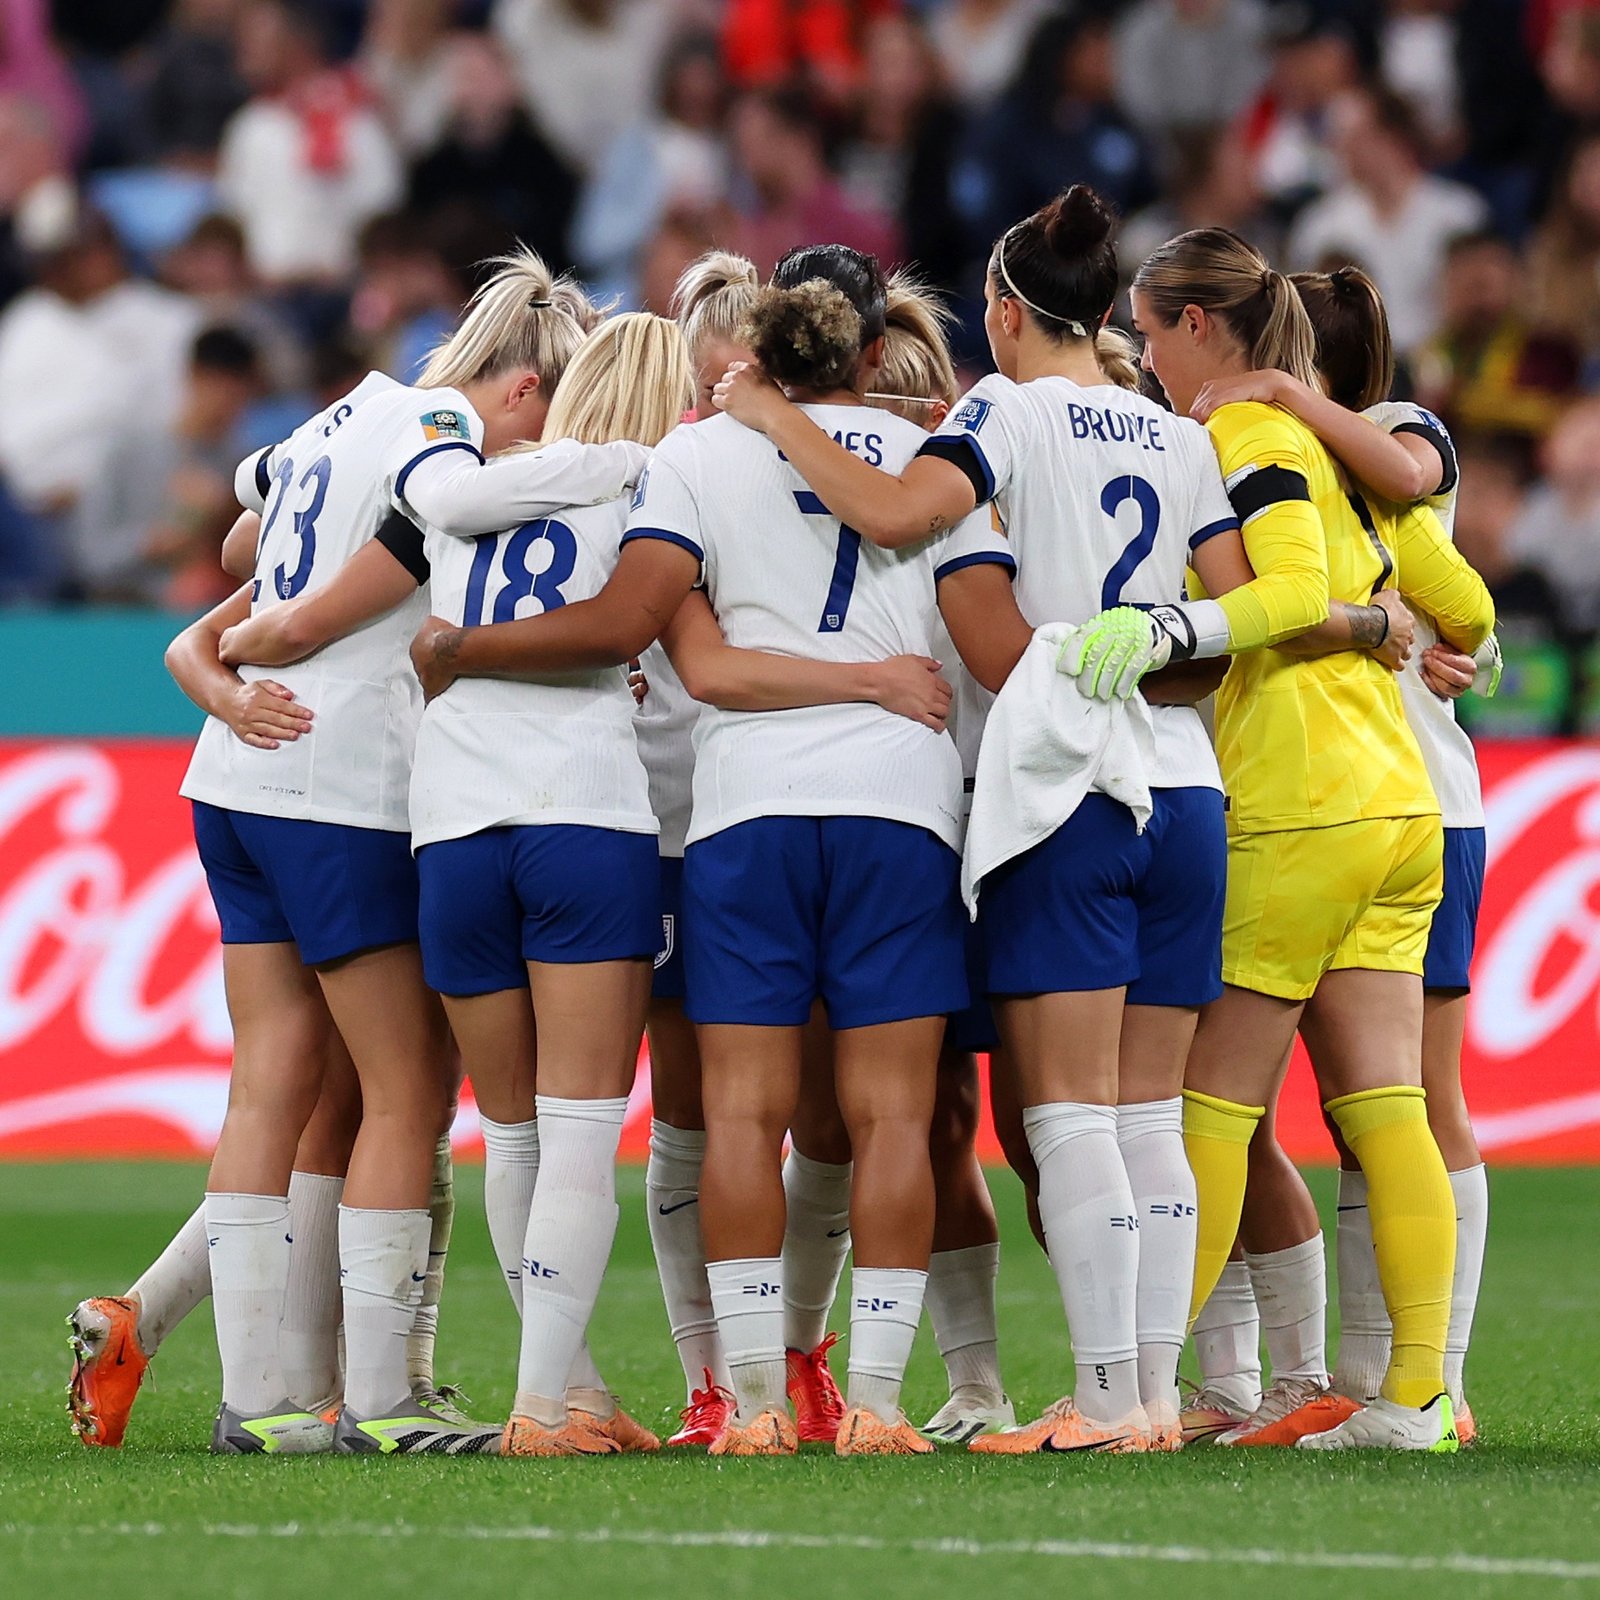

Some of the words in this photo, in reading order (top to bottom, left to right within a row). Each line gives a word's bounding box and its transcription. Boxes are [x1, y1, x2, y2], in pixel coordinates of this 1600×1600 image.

[462, 518, 578, 628] 18
[792, 491, 862, 633] 7
[1101, 475, 1161, 614] 2
